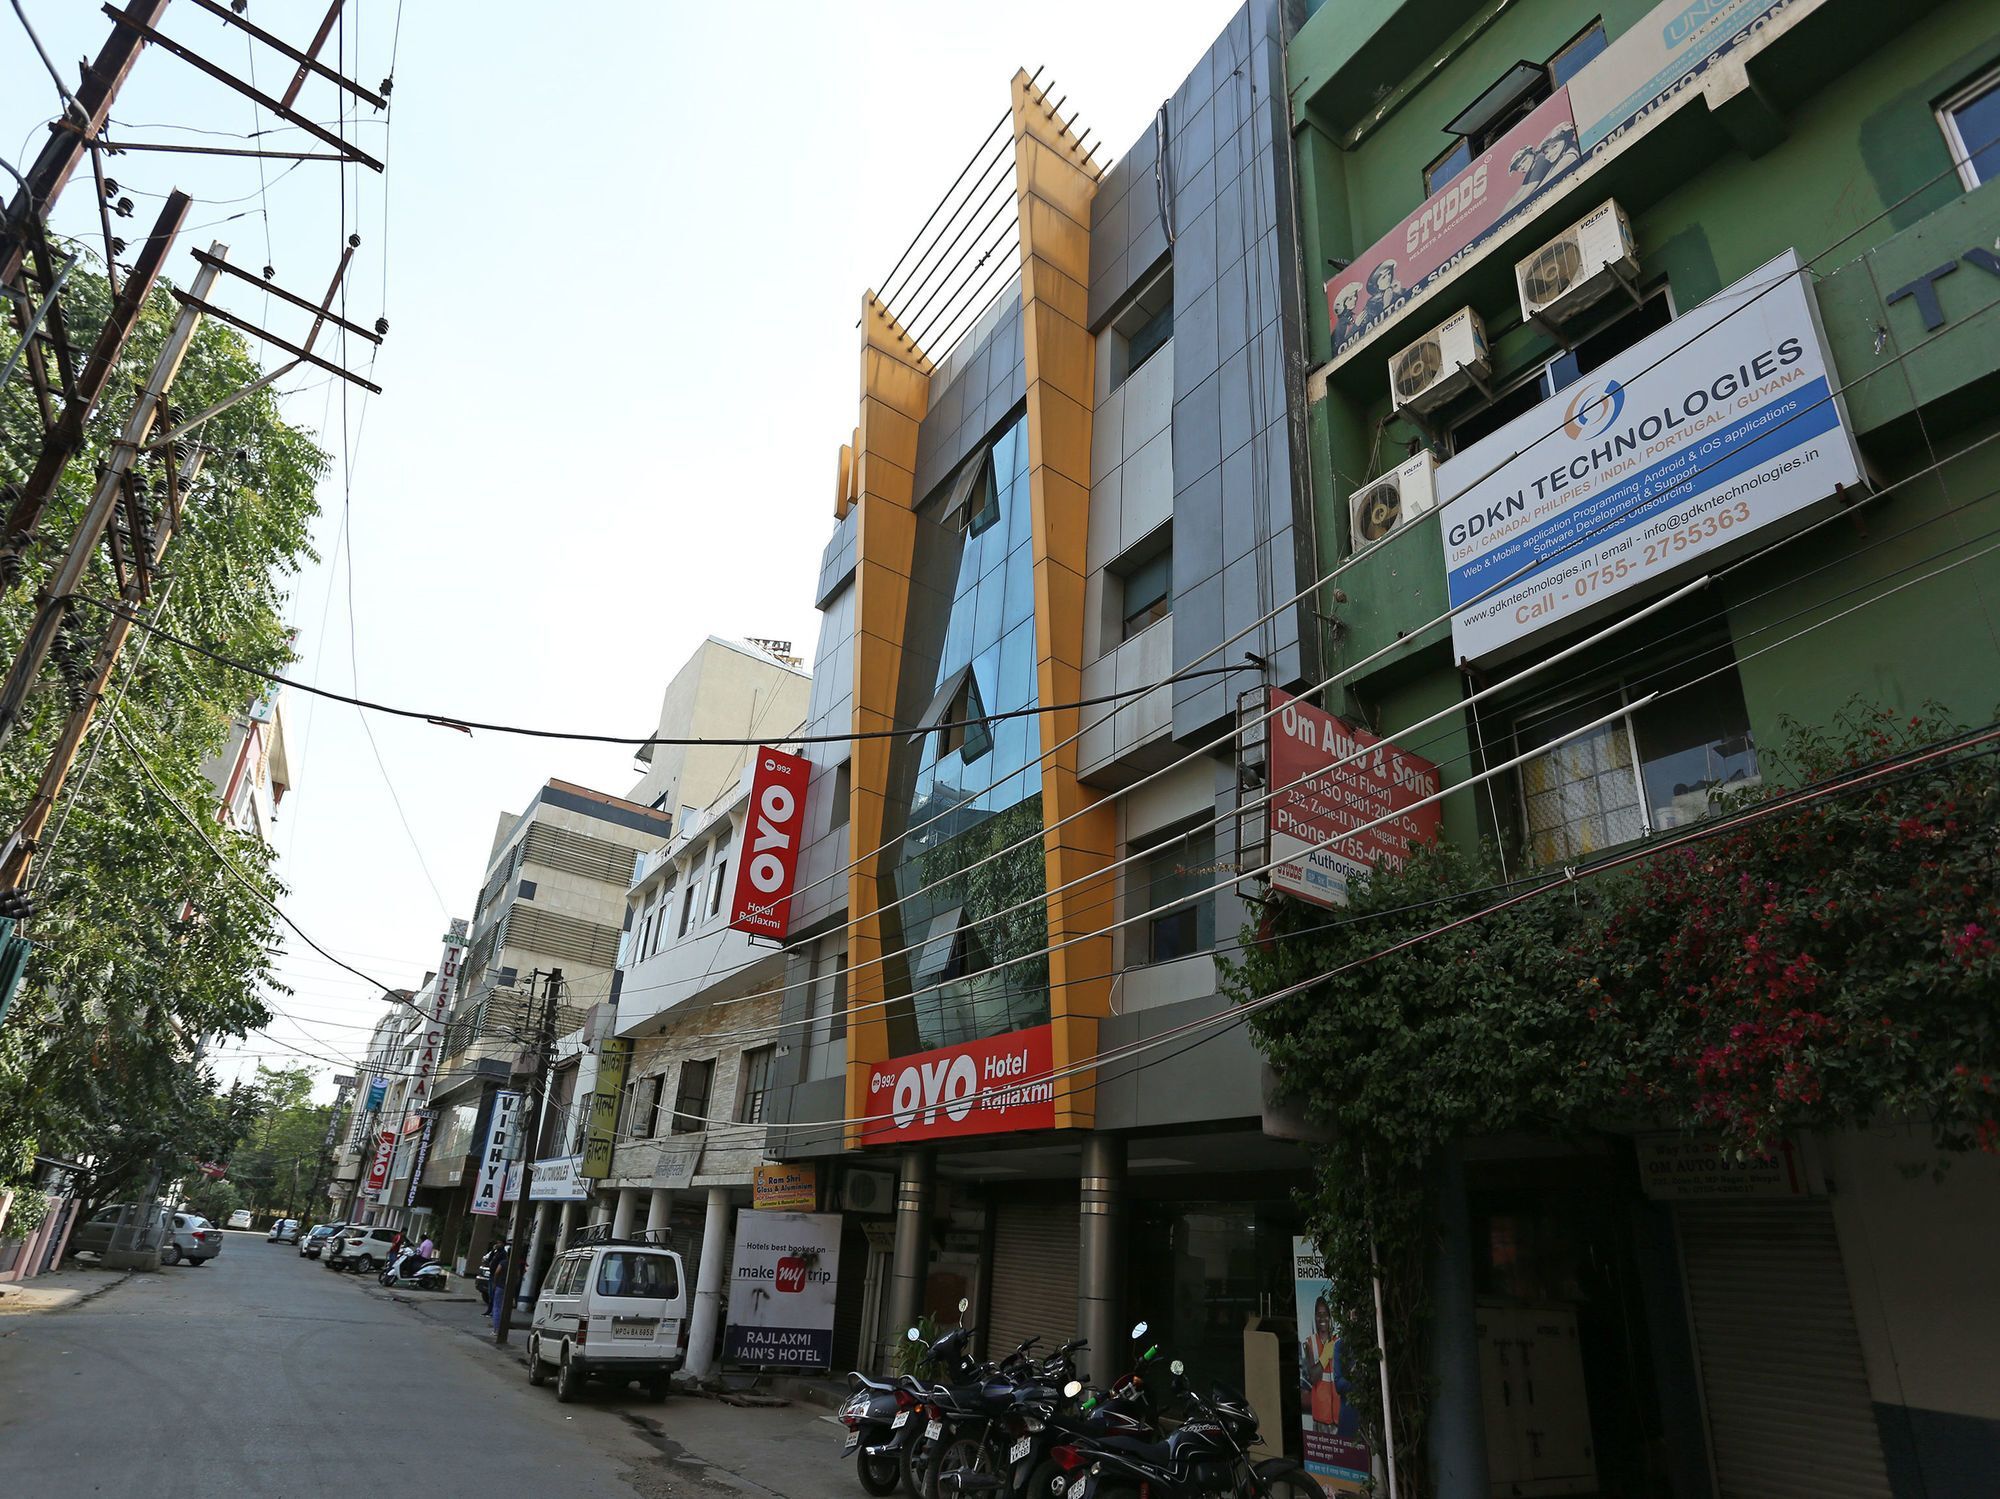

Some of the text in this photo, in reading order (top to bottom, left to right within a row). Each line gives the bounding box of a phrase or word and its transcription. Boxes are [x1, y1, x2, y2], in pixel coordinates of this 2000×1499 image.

[1592, 126, 1625, 157] OM
[1406, 164, 1488, 254] STUDDS
[1409, 239, 1436, 262] HELMETS
[1443, 196, 1488, 237] ACCESSORIES
[1580, 206, 1609, 230] VOLTAS
[1337, 243, 1476, 355] OM AUTO & SONS
[1441, 314, 1466, 333] VOLTAS
[1449, 338, 1803, 547] GDKN TECHNOLOGIES
[1452, 543, 1474, 562] USA
[1534, 482, 1591, 520] PHILIPIES
[1601, 457, 1636, 483] INDIA
[1646, 409, 1726, 458] PORTUGAL
[1737, 367, 1805, 409] GUYANA
[1462, 400, 1798, 579] Web & Mobile application Programming. Android & iOS applications
[1628, 482, 1696, 518] Outsourcing.
[1463, 559, 1593, 628] www.gdkntechnologies.in
[1601, 535, 1633, 560] email
[1644, 448, 1820, 541] info@gdkntechnologies.in
[1533, 530, 1574, 554] Software
[1575, 492, 1642, 533] Development
[1644, 487, 1652, 498] &
[1515, 593, 1556, 625] Call
[1575, 560, 1638, 599] 0755-
[1643, 501, 1751, 566] 2755363
[1282, 701, 1435, 797] Om Auto & Sons
[776, 765, 792, 775] 992
[1301, 771, 1317, 793] An
[1320, 779, 1342, 802] ISO
[1402, 816, 1421, 835] Co.
[1359, 775, 1392, 807] Floor)
[750, 785, 795, 893] OYO
[1311, 797, 1348, 828] Zone-II
[1370, 826, 1399, 849] Nagar,
[738, 911, 781, 929] Rajlaxmi
[747, 902, 774, 916] Hotel
[413, 947, 460, 1096] TULSI CASA
[881, 1074, 895, 1088] 992
[981, 1082, 1053, 1115] Rajlaxmi
[893, 1049, 1028, 1130] OYO Hotel
[373, 1143, 391, 1176] OYO
[481, 1097, 514, 1199] VIDHYA
[1677, 1159, 1716, 1172] AUTO
[756, 1184, 773, 1193] Glass
[780, 1183, 813, 1192] Aluminium
[768, 1174, 801, 1185] Ram Shri
[746, 1241, 826, 1254] Hotels best booked on
[739, 1264, 831, 1290] make my trip
[735, 1347, 821, 1361] JAIN'S HOTEL
[746, 1331, 812, 1346] RAJLAXMI
